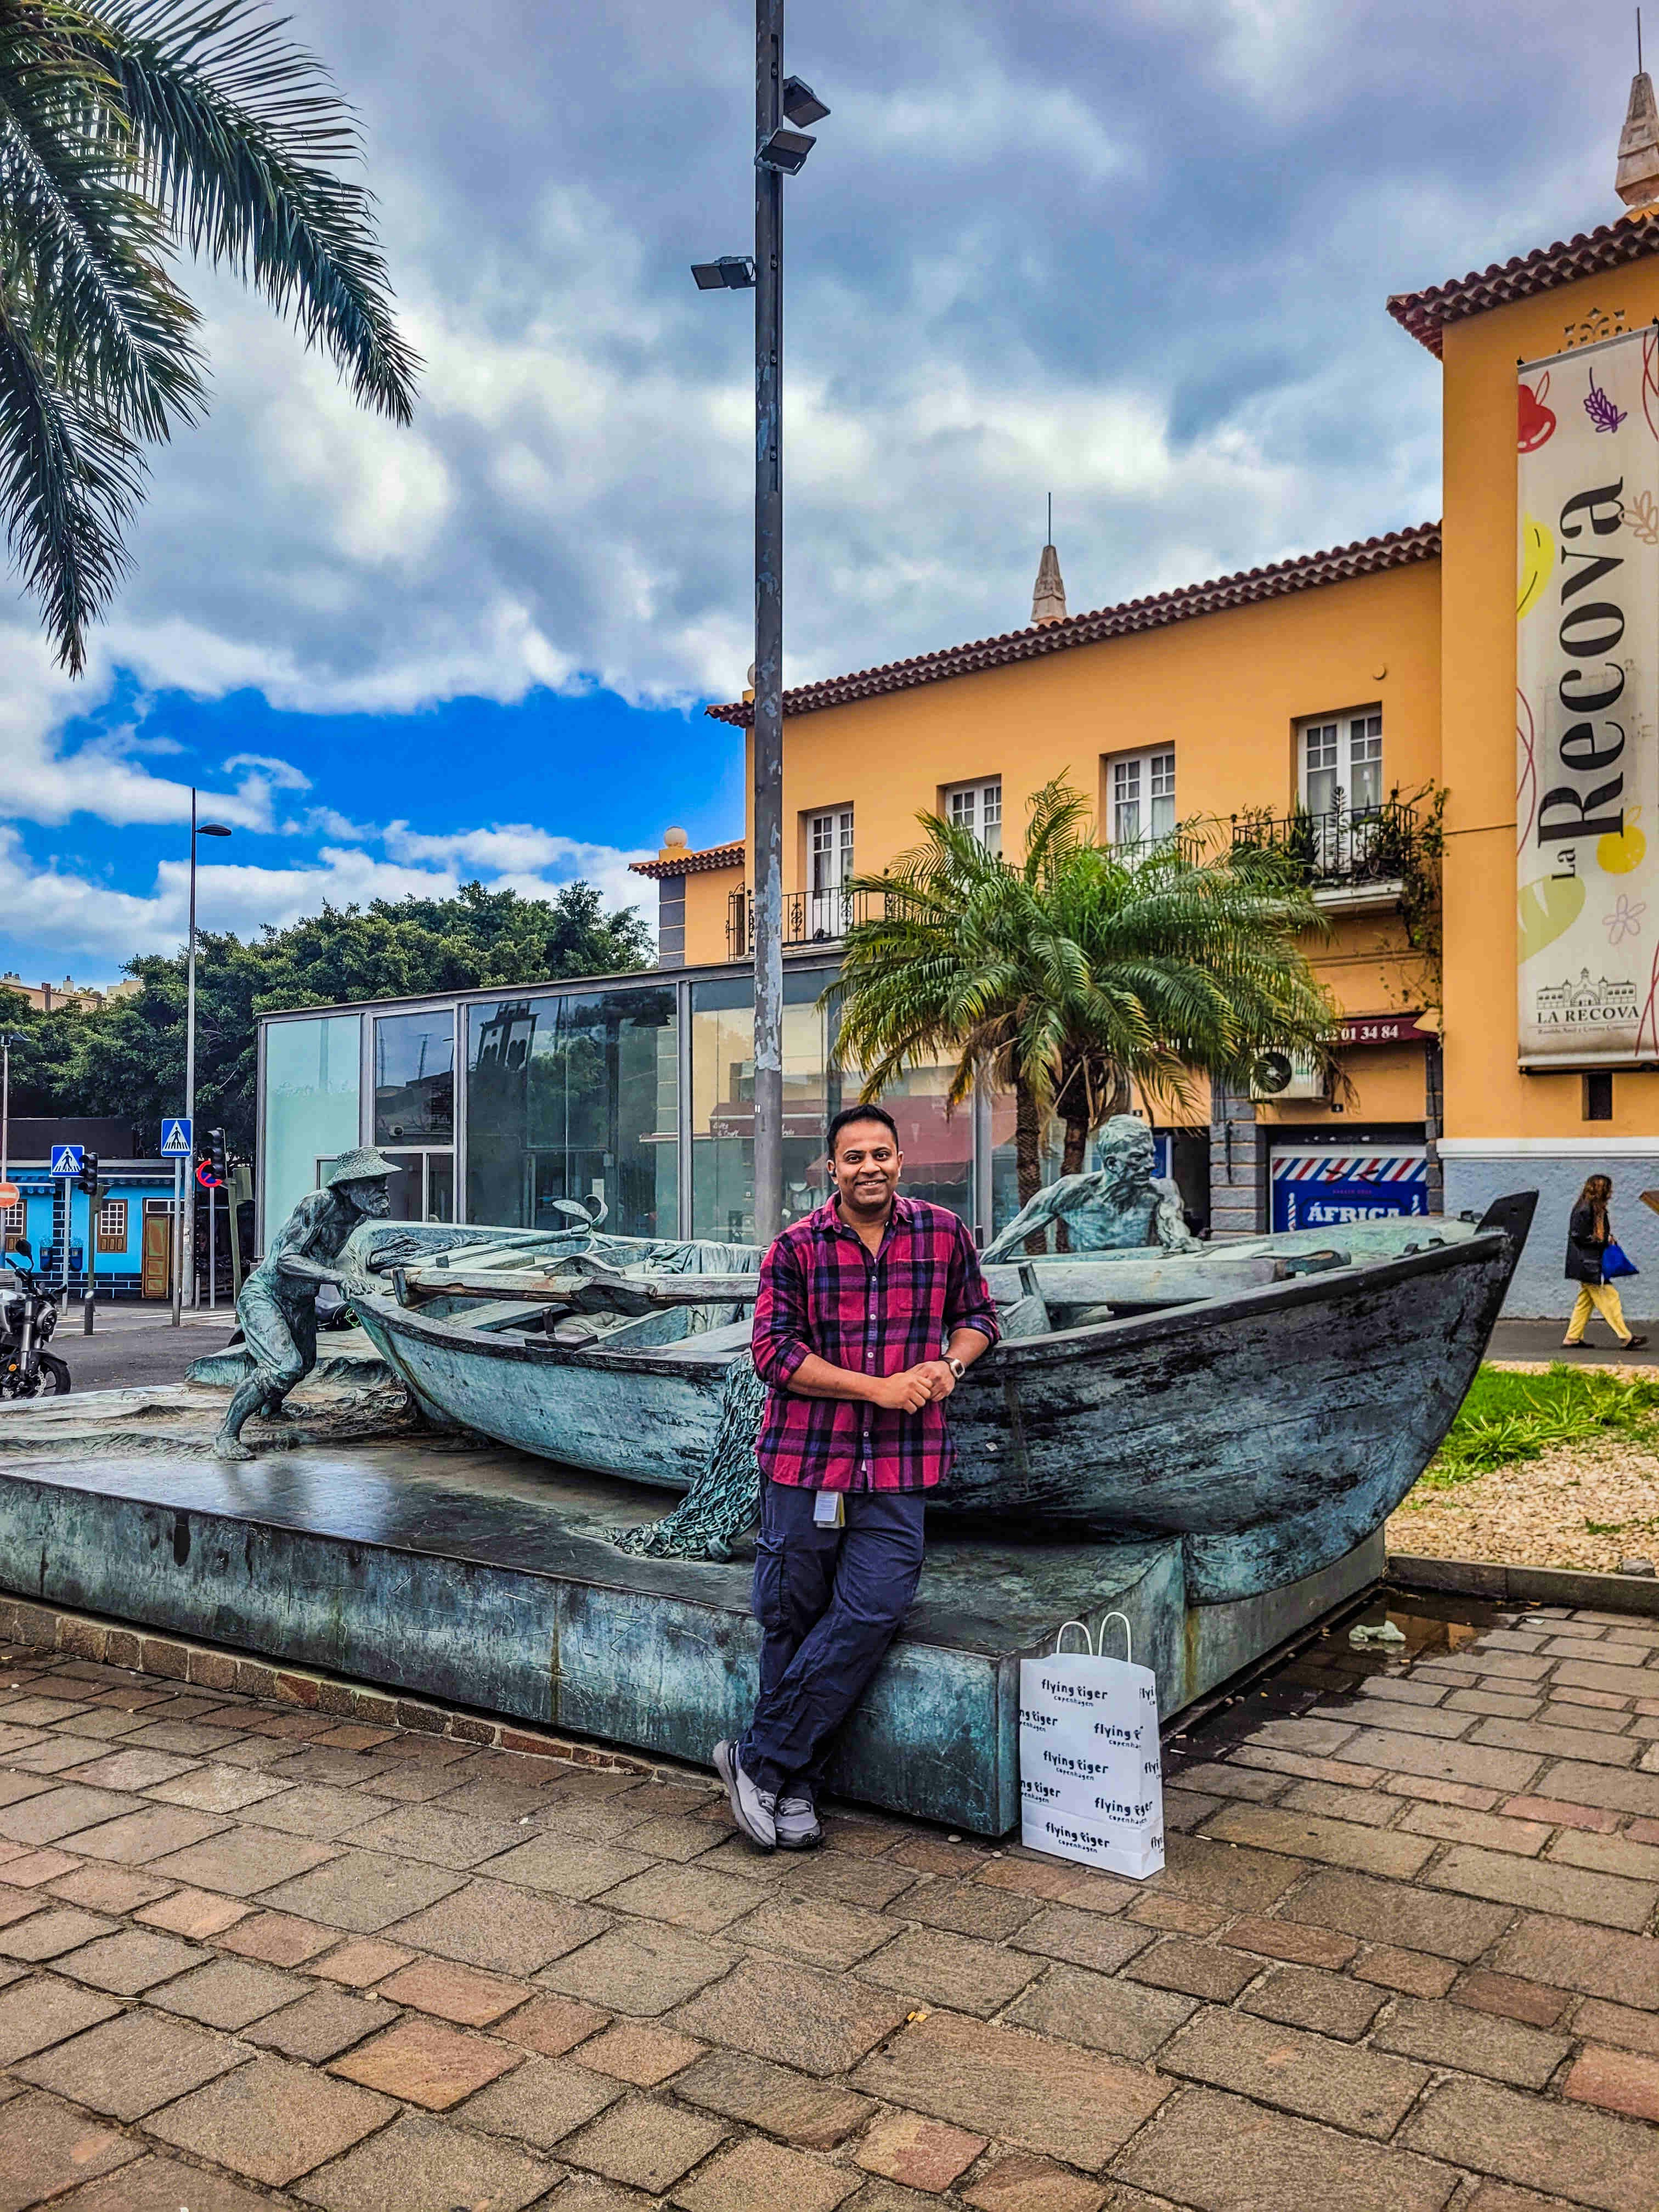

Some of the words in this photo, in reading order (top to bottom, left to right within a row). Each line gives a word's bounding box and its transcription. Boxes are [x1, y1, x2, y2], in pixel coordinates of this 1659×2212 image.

[1537, 476, 1624, 848] Recova
[1551, 848, 1576, 880] La
[1537, 1011, 1559, 1024] LA
[1565, 1006, 1640, 1022] RECOVA
[1341, 1027, 1357, 1041] 01
[1361, 1026, 1378, 1040] 34
[1381, 1024, 1398, 1039] 84
[1041, 1679, 1075, 1696] flying
[1077, 1686, 1108, 1700] tiger
[1054, 1695, 1093, 1707] copenhagen
[1031, 1711, 1058, 1726] tiger
[1094, 1723, 1131, 1740] flying
[1043, 1750, 1075, 1770] flying
[1077, 1759, 1109, 1774] tiger
[1056, 1768, 1094, 1781] copenhagen
[1034, 1781, 1061, 1797] tiger
[1095, 1797, 1131, 1816] flying
[1046, 1822, 1077, 1842] flying
[1080, 1832, 1110, 1848] tiger
[1058, 1839, 1098, 1853] copenhagen
